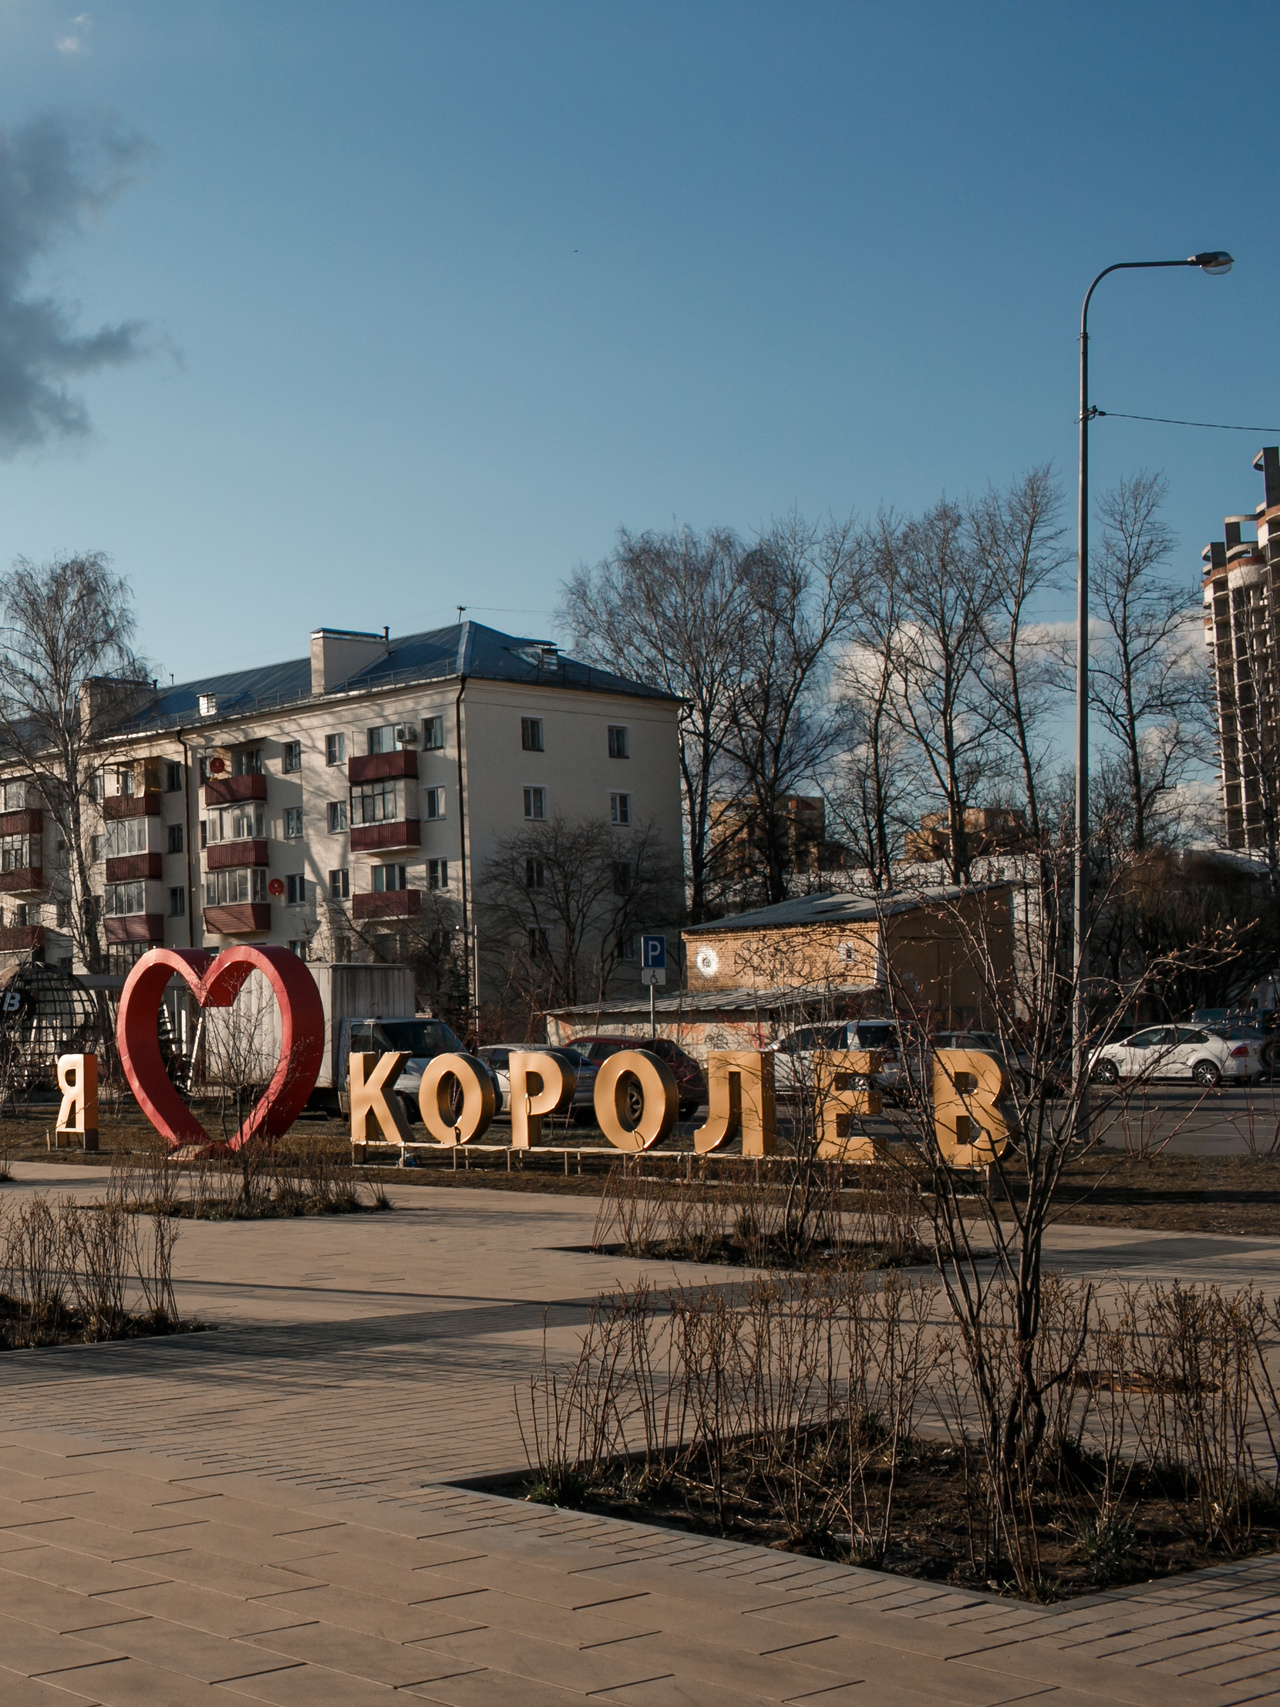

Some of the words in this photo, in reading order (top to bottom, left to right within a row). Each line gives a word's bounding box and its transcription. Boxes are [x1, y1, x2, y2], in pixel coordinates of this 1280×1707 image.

[648, 940, 661, 966] P
[56, 1053, 95, 1132] Я
[349, 1049, 1016, 1165] КОРОЛЕВ
